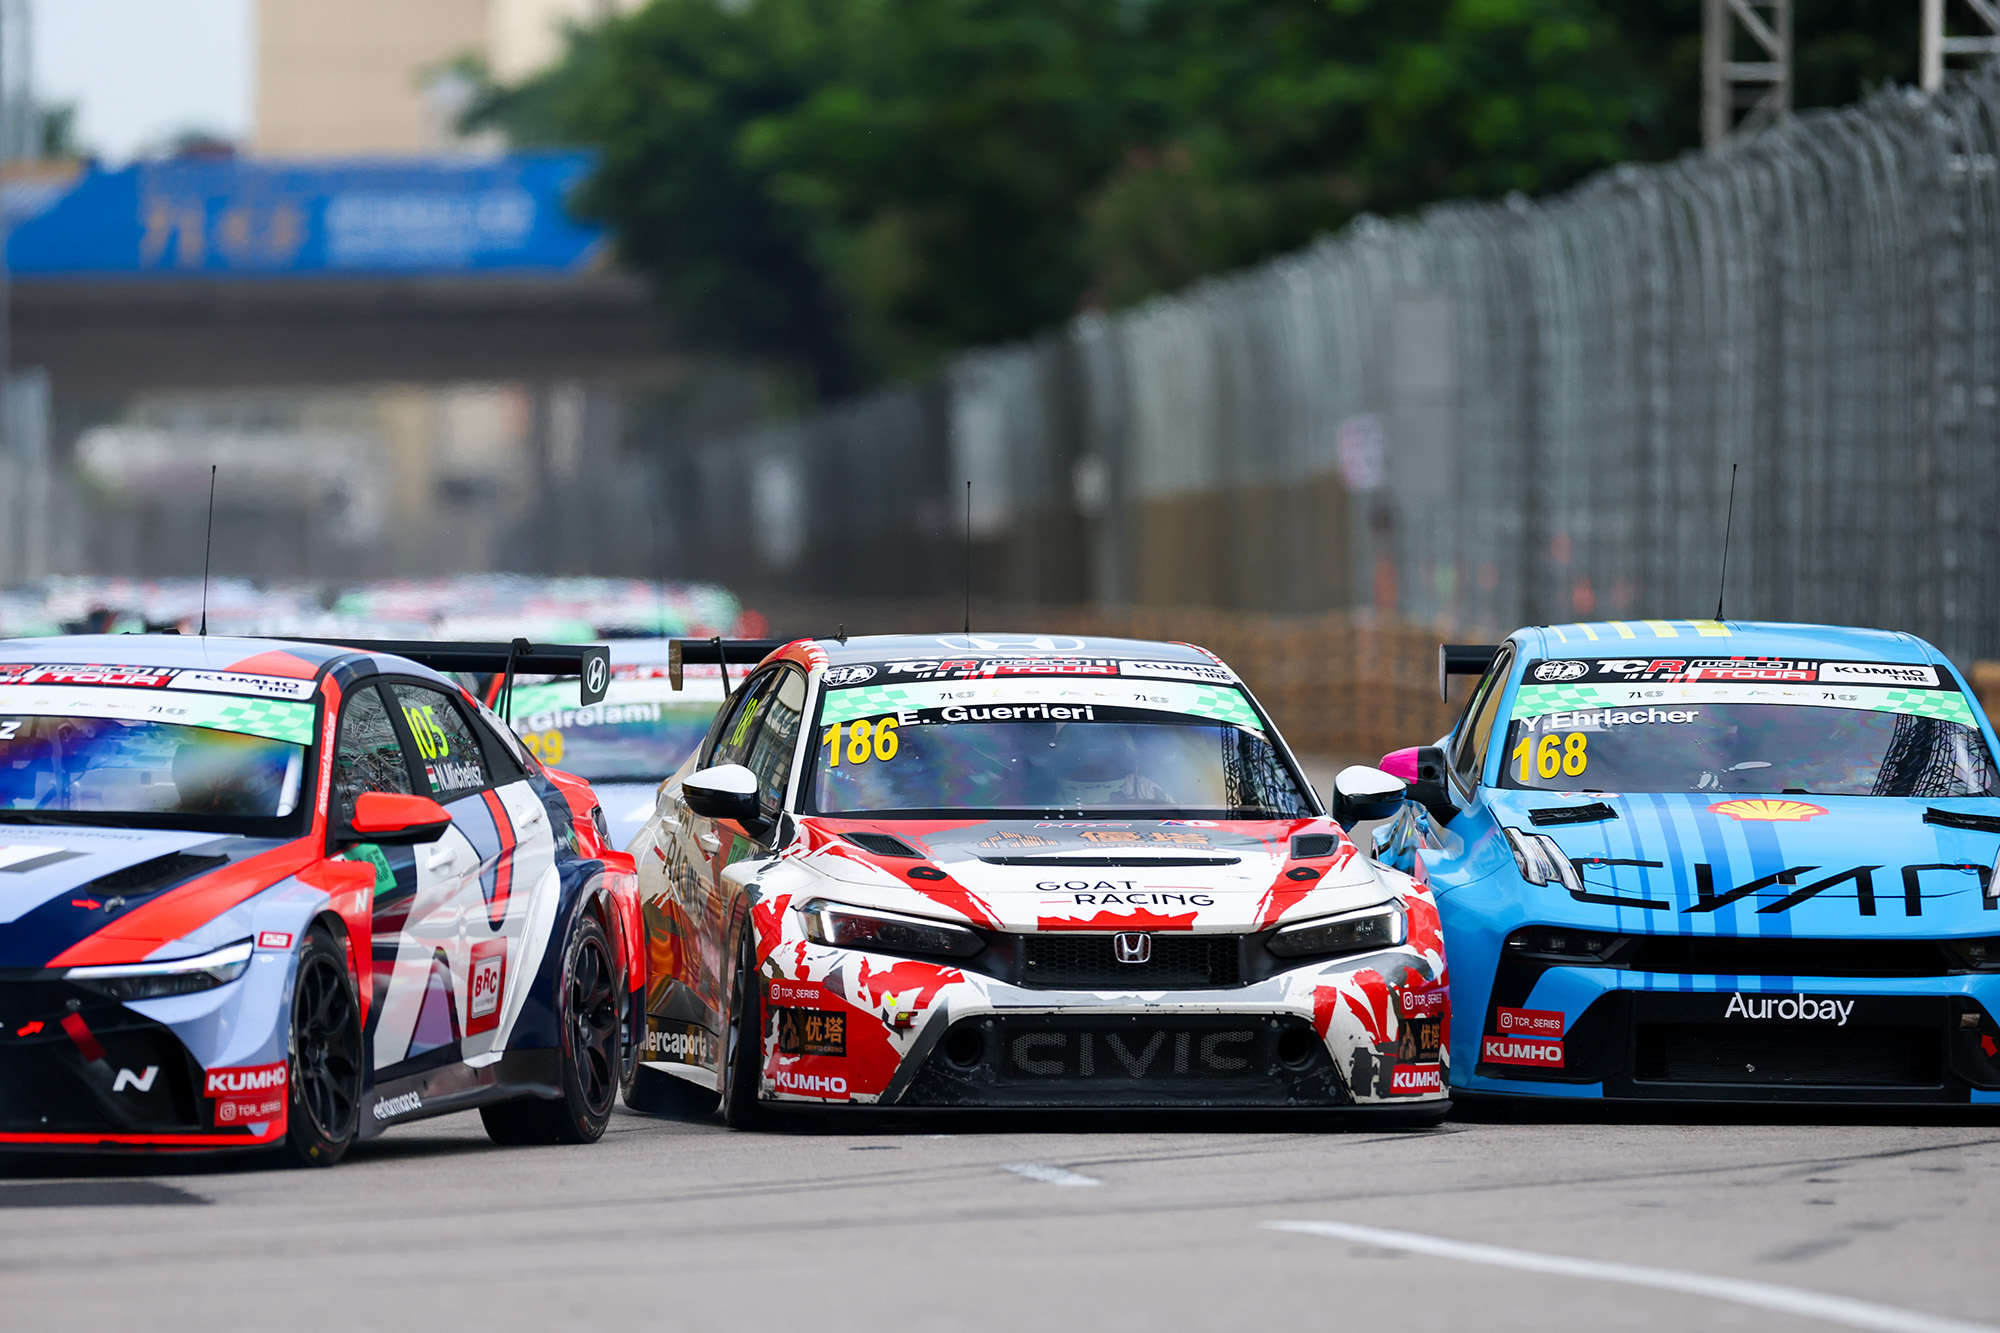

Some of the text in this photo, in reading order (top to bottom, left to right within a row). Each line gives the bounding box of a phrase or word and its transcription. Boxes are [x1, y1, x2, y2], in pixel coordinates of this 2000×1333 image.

[885, 659, 1088, 675] TCR WORLD
[1004, 666, 1108, 674] TOUR
[1134, 663, 1227, 675] KUMHO
[1597, 660, 1784, 674] TCR WORLD
[1709, 669, 1807, 680] TOUR
[1834, 665, 1925, 677] KUMHO
[51, 673, 160, 686] TOUR
[194, 673, 300, 688] KUMHO
[1191, 671, 1232, 681] TIRE
[1889, 675, 1929, 683] TIRE
[255, 684, 300, 695] TIRE
[899, 703, 1095, 727] E. Guerrieri
[401, 705, 450, 759] 105
[822, 716, 900, 768] 186
[1512, 732, 1588, 782] 168
[1035, 880, 1138, 892] GOAT
[1074, 893, 1215, 907] RACING
[475, 967, 498, 998] BRC
[781, 987, 819, 1000] TCR_SERIES
[1725, 992, 1855, 1026] Aurobay
[806, 1015, 844, 1044] 优塔
[1514, 1016, 1561, 1030] TCR_SERIES
[1012, 1031, 1254, 1079] CIVIC
[1486, 1041, 1562, 1062] KUMHO
[207, 1066, 287, 1092] KUMHO
[776, 1071, 848, 1093] KUMHO
[1393, 1070, 1441, 1088] KUMHO
[238, 1100, 282, 1117] TCR_SERIES
